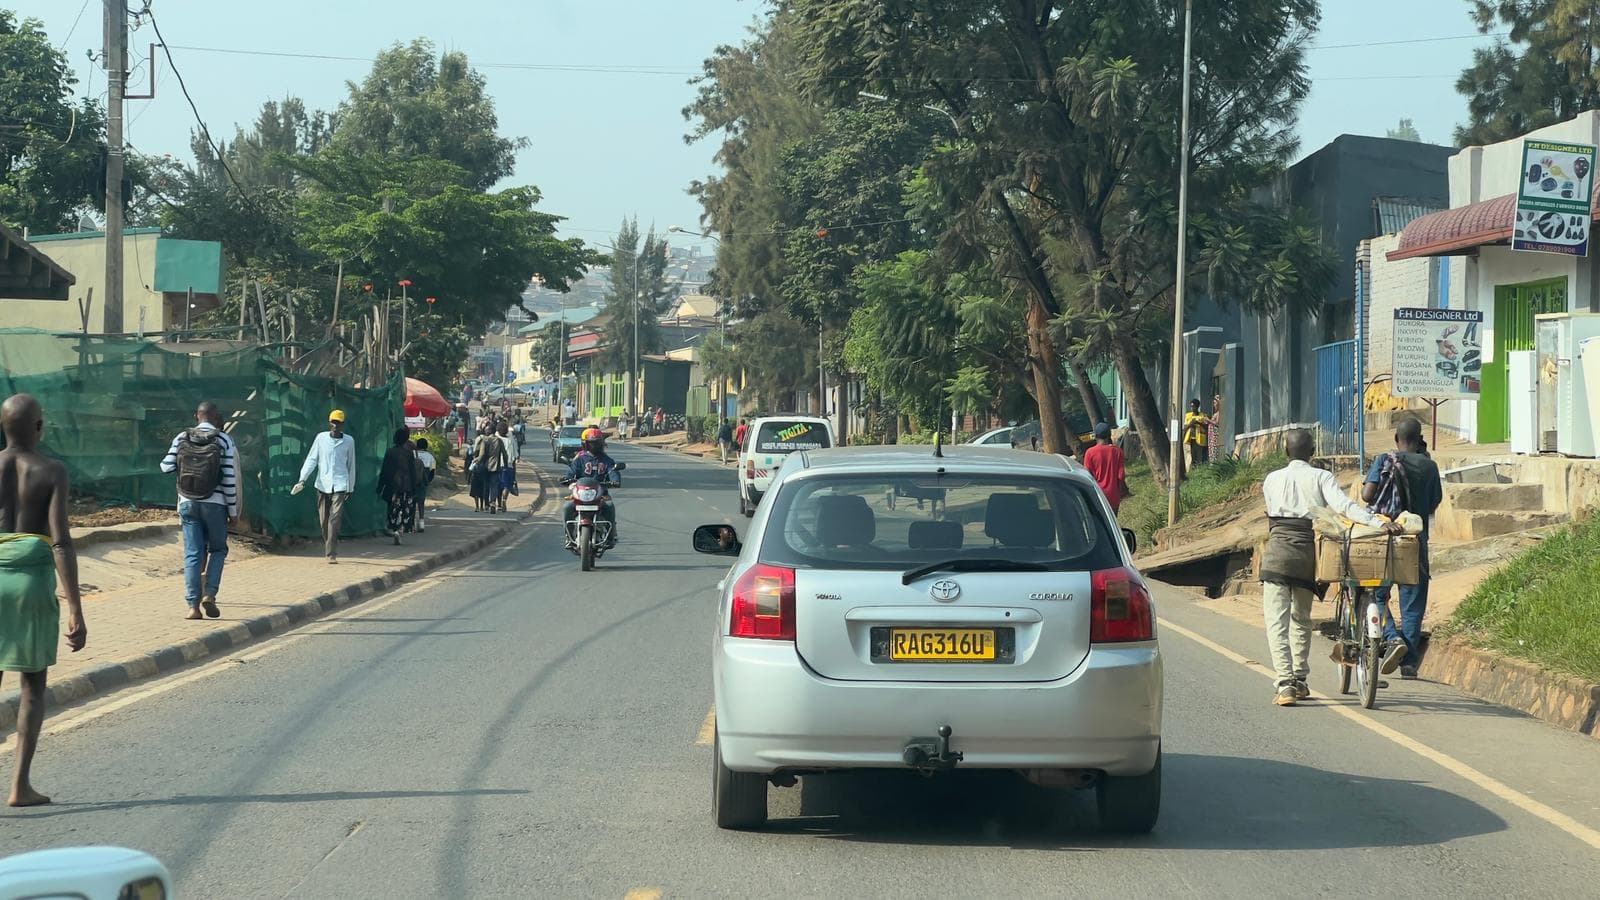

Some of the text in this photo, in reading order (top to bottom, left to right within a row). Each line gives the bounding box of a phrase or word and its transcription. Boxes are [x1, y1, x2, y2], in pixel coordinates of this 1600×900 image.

[1541, 144, 1577, 153] DESIGNER
[1399, 310, 1478, 320] F.H DESIGNER Ltd
[1396, 361, 1432, 369] TUGASANA
[894, 632, 985, 655] RAG316U
